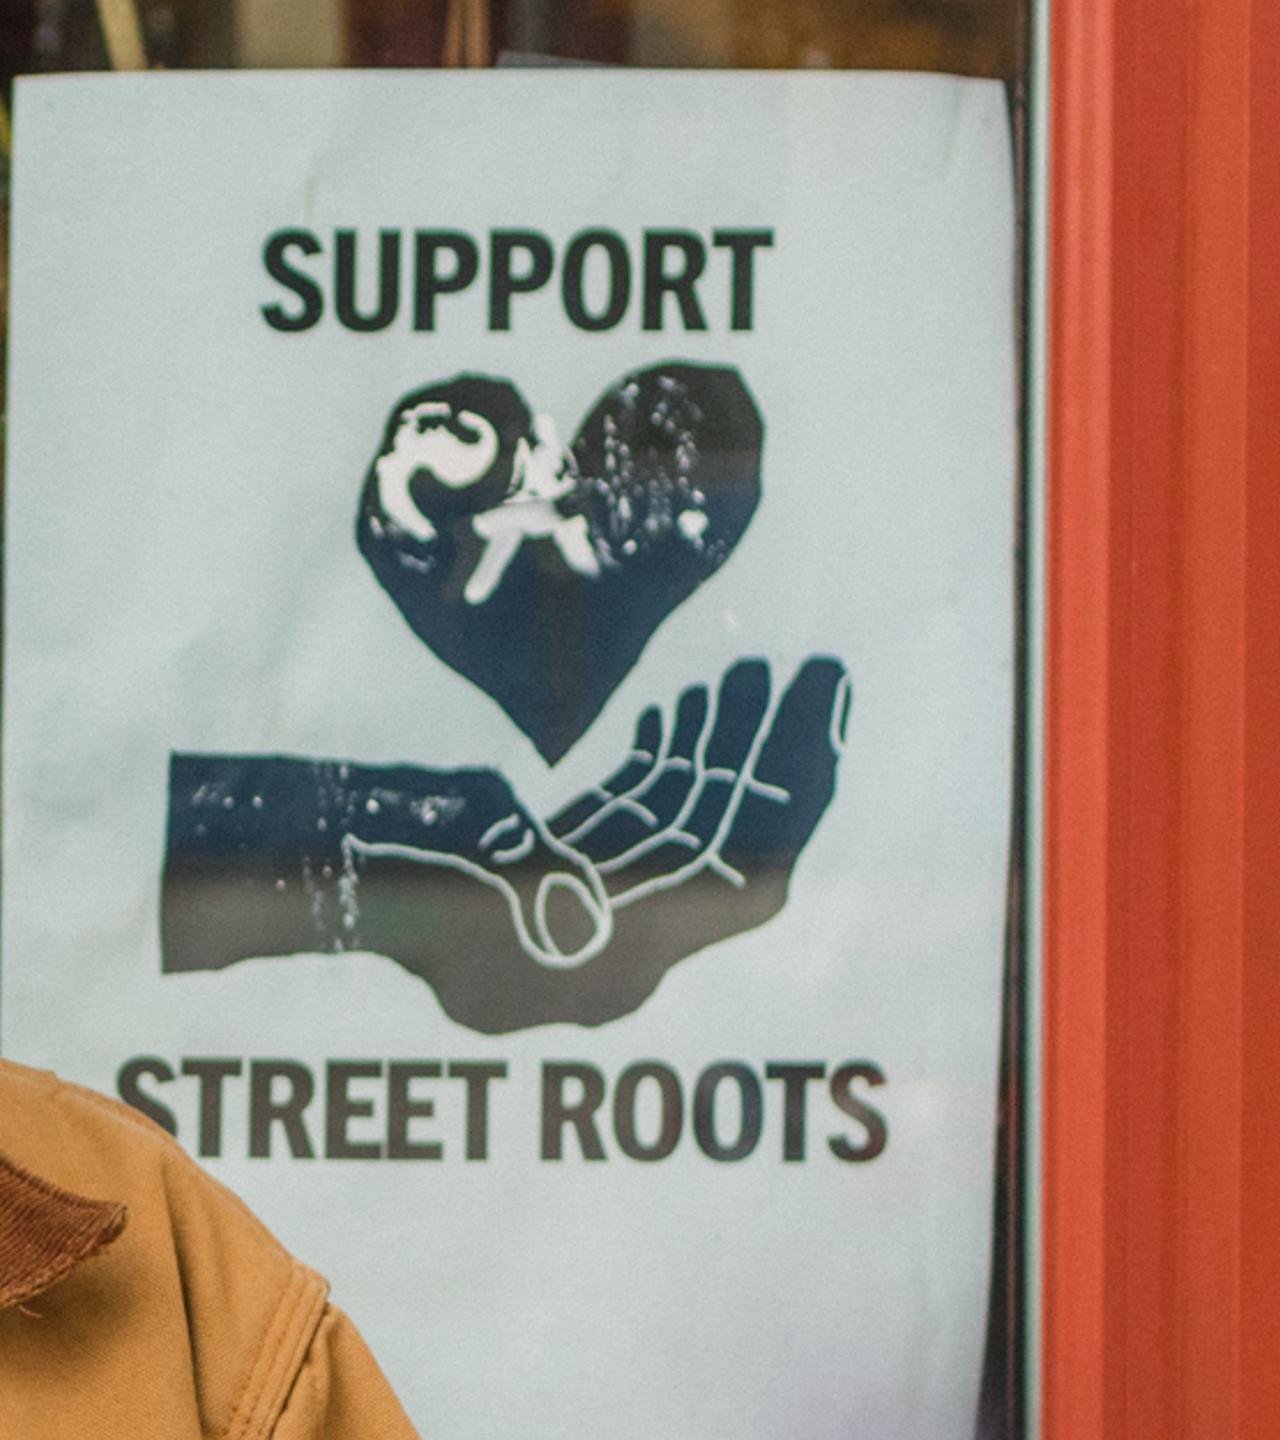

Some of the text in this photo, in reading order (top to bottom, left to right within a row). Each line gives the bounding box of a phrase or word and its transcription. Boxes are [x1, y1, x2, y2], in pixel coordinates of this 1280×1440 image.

[259, 227, 774, 335] SUPPORT
[115, 1055, 889, 1164] STREET ROOTS
